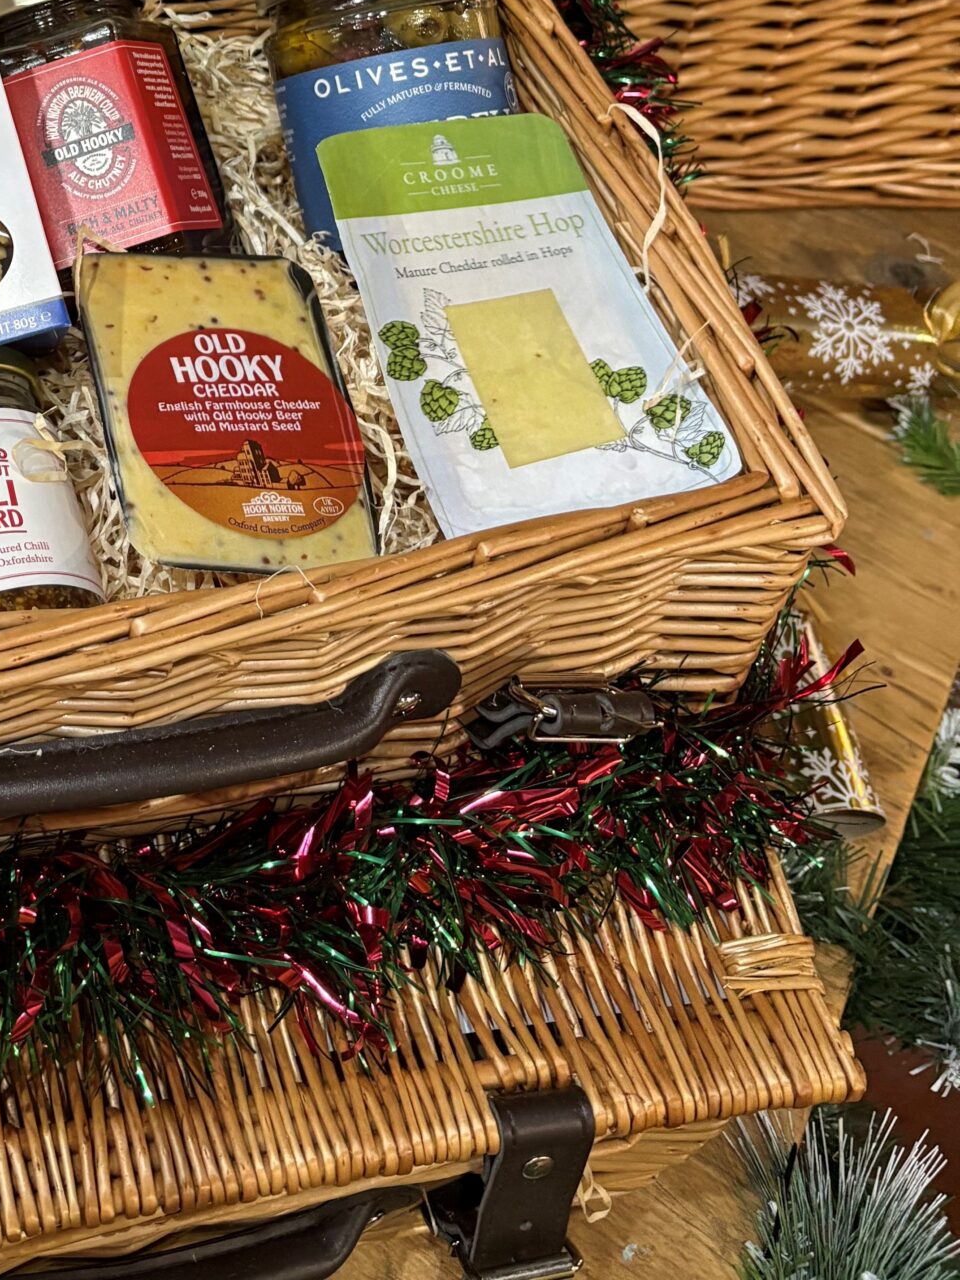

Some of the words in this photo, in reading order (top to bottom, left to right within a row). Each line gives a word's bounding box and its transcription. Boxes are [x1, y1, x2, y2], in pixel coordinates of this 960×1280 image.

[47, 91, 70, 119] NORTON
[68, 85, 106, 104] BREWERY
[360, 101, 386, 122] FULLY
[387, 83, 432, 106] MATURED
[434, 83, 443, 92] &
[443, 82, 492, 99] FERMENTED
[45, 118, 60, 141] HOOK
[54, 144, 79, 161] OLD
[81, 128, 125, 152] HOOKY
[68, 171, 88, 187] ALE
[88, 154, 127, 189] CHUTNEY
[403, 164, 499, 185] CROOME
[431, 183, 479, 197] CHEESE
[67, 217, 99, 236] RH
[102, 210, 112, 224] &
[114, 195, 158, 220] MALTY
[361, 220, 526, 256] Worcestershire
[527, 211, 585, 240] Hop
[395, 267, 437, 280] Mature
[440, 260, 489, 275] Cheddar
[491, 253, 524, 268] rolled
[527, 251, 539, 261] in
[540, 245, 573, 260] Hops
[13, 316, 37, 331] 80g
[194, 333, 246, 354] OLD
[169, 354, 284, 383] HOOKY
[193, 383, 279, 398] CHEDDAR
[158, 401, 202, 412] English
[205, 400, 272, 411] Farmhouse
[274, 400, 321, 410] Cheddar
[184, 411, 210, 421] with
[212, 411, 233, 421] Old
[236, 410, 272, 422] Hooky
[276, 410, 303, 420] Beer
[194, 422, 216, 432] and
[219, 421, 269, 432] Mustard
[272, 421, 301, 431] Seed
[243, 504, 269, 515] HOOK
[269, 504, 305, 514] NORTON
[228, 517, 258, 532] Oxford
[260, 525, 289, 534] Cheese
[290, 517, 327, 533] Company
[24, 541, 50, 551] Chilli
